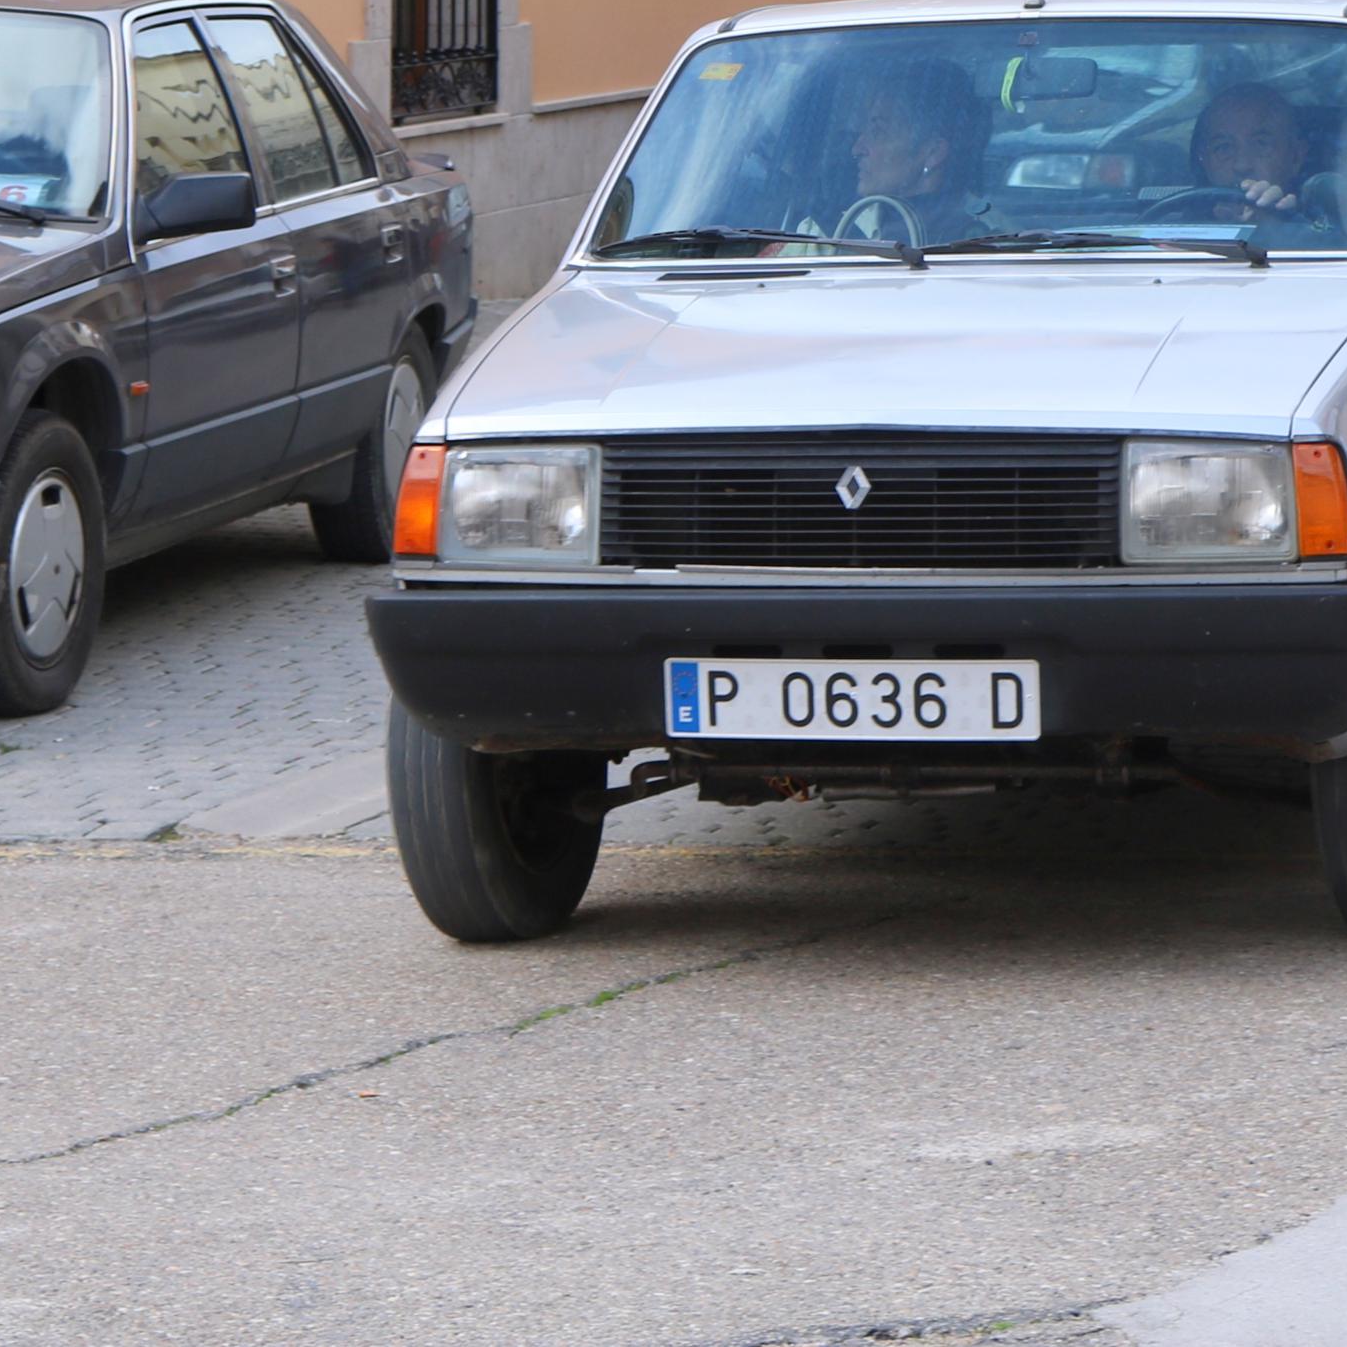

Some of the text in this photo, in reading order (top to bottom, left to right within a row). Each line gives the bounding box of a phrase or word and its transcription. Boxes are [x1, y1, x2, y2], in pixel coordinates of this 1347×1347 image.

[679, 706, 693, 723] E
[707, 670, 1024, 729] P 0636 D
